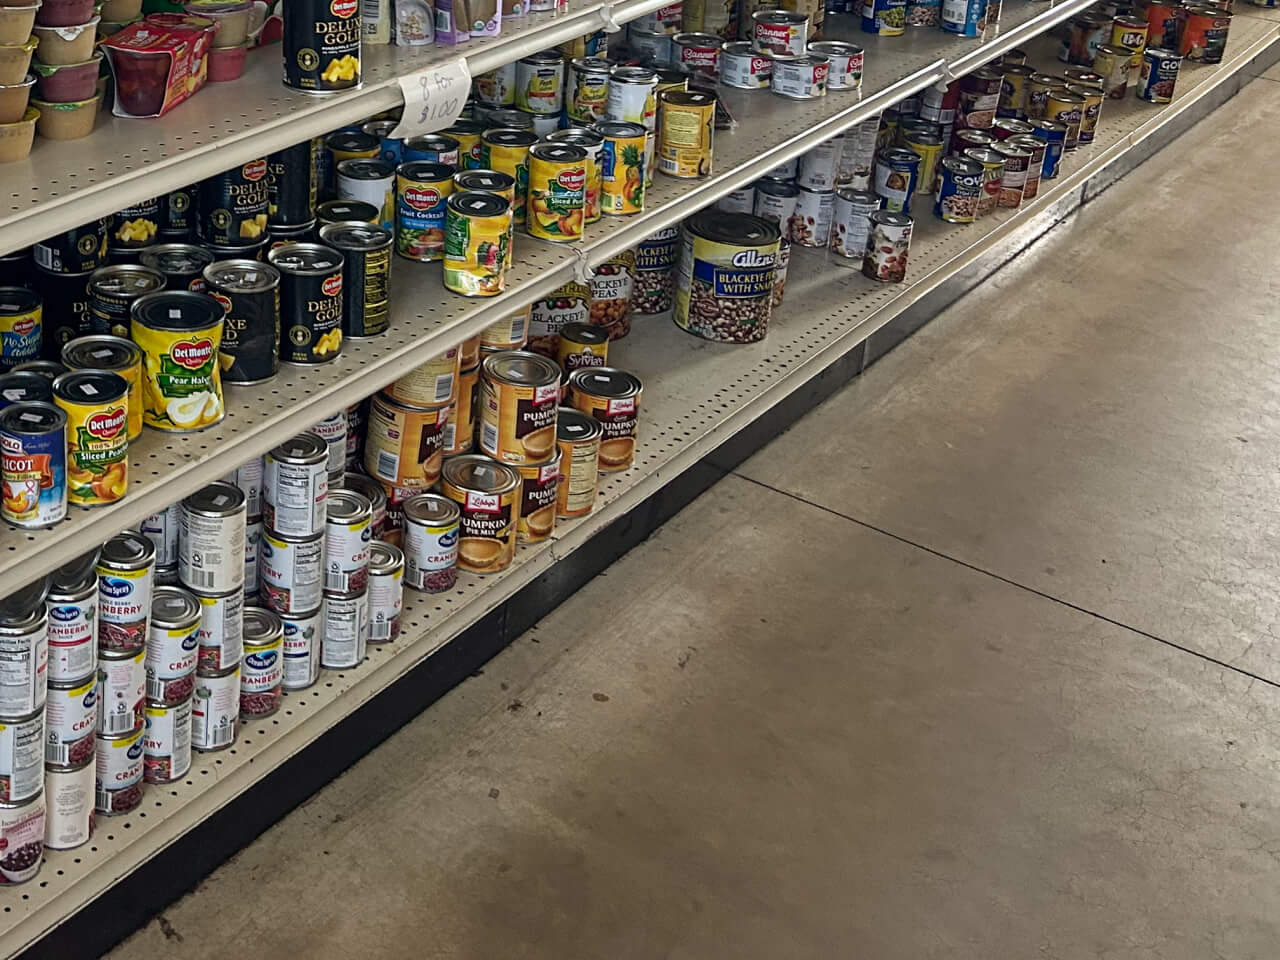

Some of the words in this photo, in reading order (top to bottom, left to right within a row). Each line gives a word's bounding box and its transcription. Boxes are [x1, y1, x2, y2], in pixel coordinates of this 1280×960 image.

[756, 27, 789, 38] Banner
[683, 48, 717, 61] Banner
[419, 75, 430, 97] 8
[719, 272, 765, 284] BLACKEYE
[592, 288, 617, 298] PEAS
[723, 283, 750, 293] WITH
[532, 310, 584, 323] BLACKEYE
[174, 347, 187, 359] Del
[188, 344, 212, 358] Monte
[170, 375, 189, 386] Pear
[91, 419, 104, 430] Del
[81, 451, 105, 461] Sliced
[472, 497, 498, 508] Libby's
[466, 527, 479, 536] PIE
[480, 528, 495, 536] MIX
